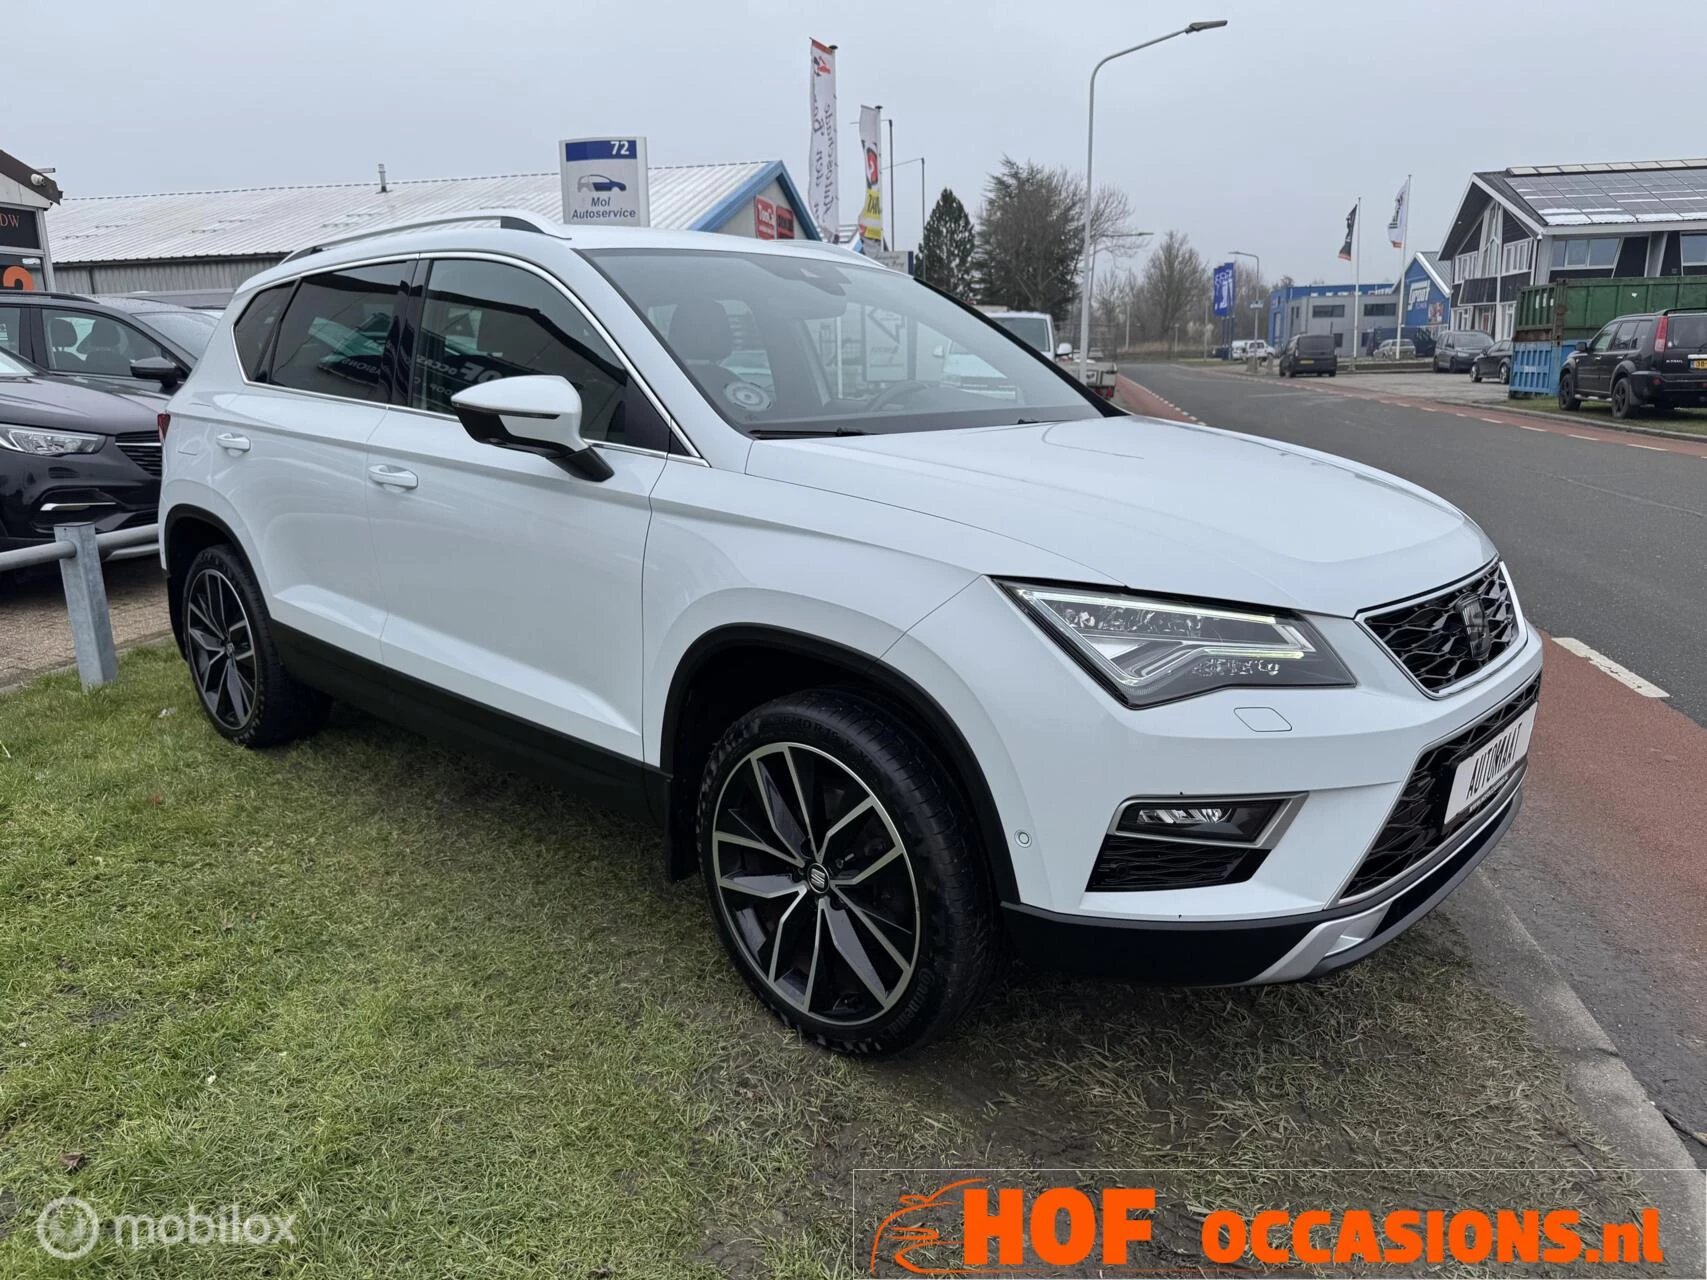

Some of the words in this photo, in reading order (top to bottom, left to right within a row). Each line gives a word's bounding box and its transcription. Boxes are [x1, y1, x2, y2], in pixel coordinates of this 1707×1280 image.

[610, 140, 630, 155] 72
[591, 196, 611, 207] Mol
[571, 208, 636, 220] Autoservice
[1465, 721, 1523, 801] AUTOMAAT
